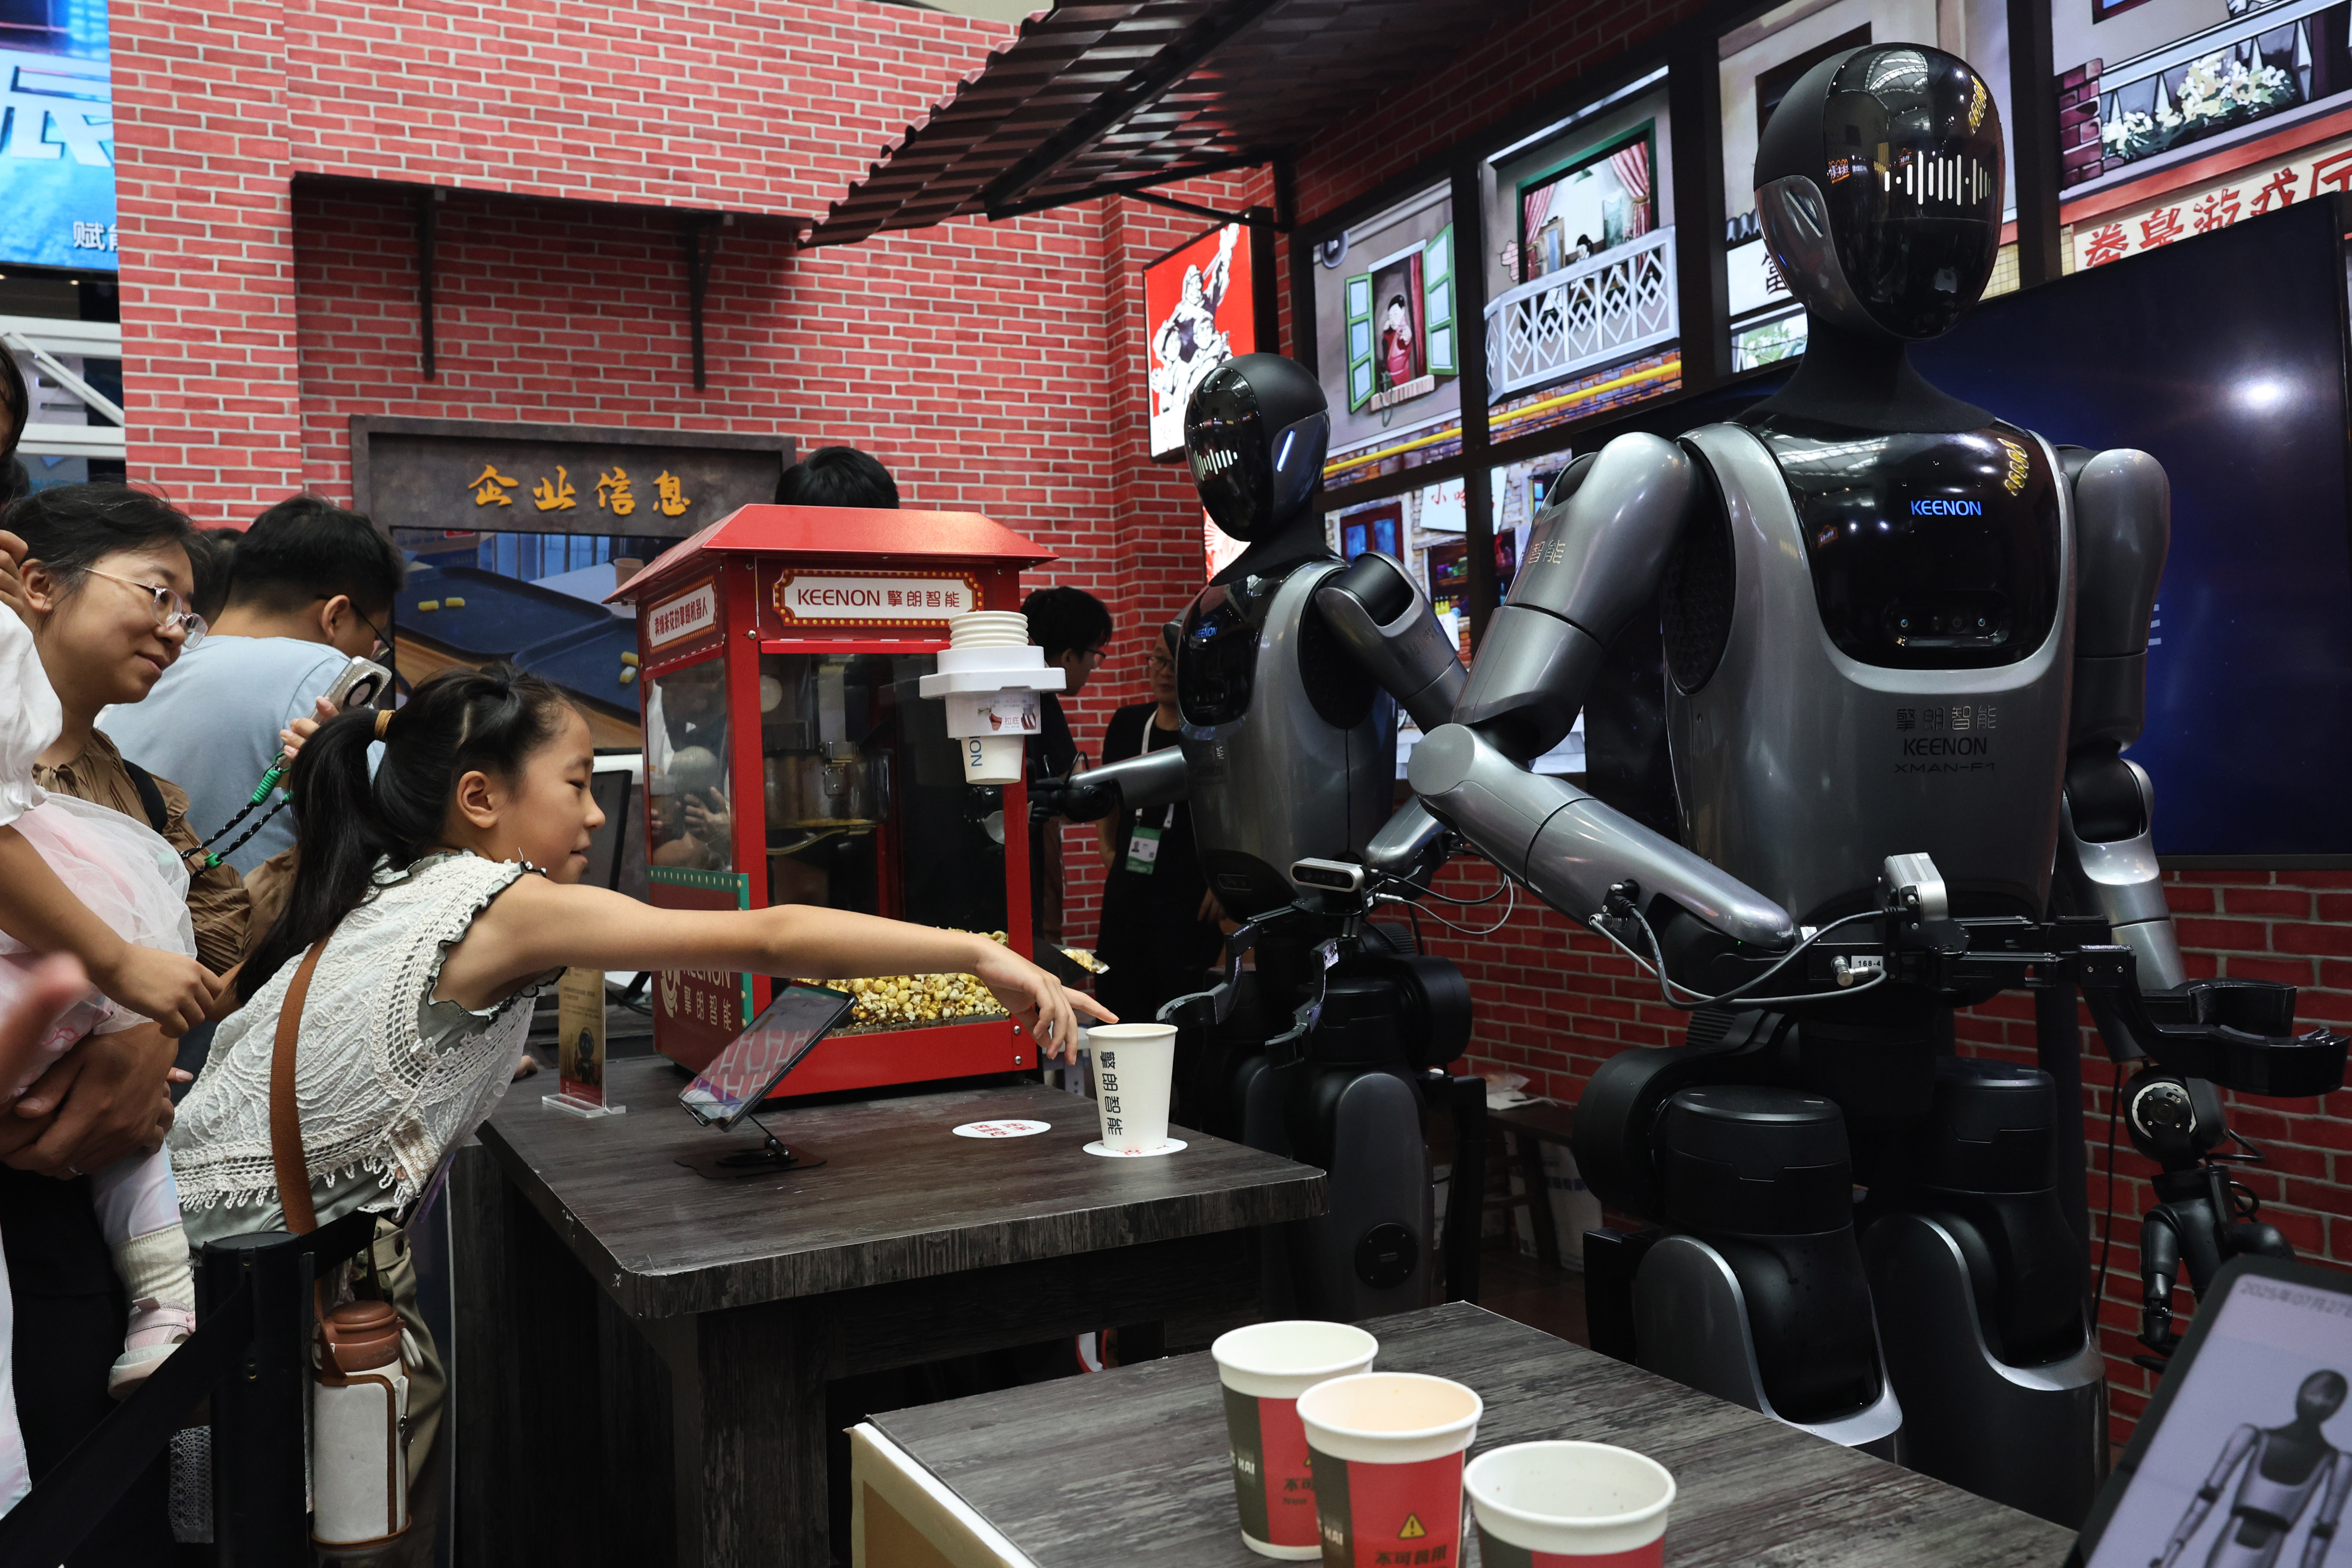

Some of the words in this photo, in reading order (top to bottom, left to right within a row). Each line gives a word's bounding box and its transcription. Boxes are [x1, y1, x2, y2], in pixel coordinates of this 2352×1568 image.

[73, 221, 118, 252] 赋
[467, 463, 691, 516] 企业信息
[1910, 500, 1982, 516] KEENON
[798, 589, 880, 606] KEENON
[887, 590, 960, 607] 擎朗智能
[1896, 705, 1996, 732] 擎朗智能
[1903, 737, 1987, 756] KEENON
[1894, 763, 1995, 773] XMAN-F1
[1100, 1051, 1123, 1136] 擎朗智能
